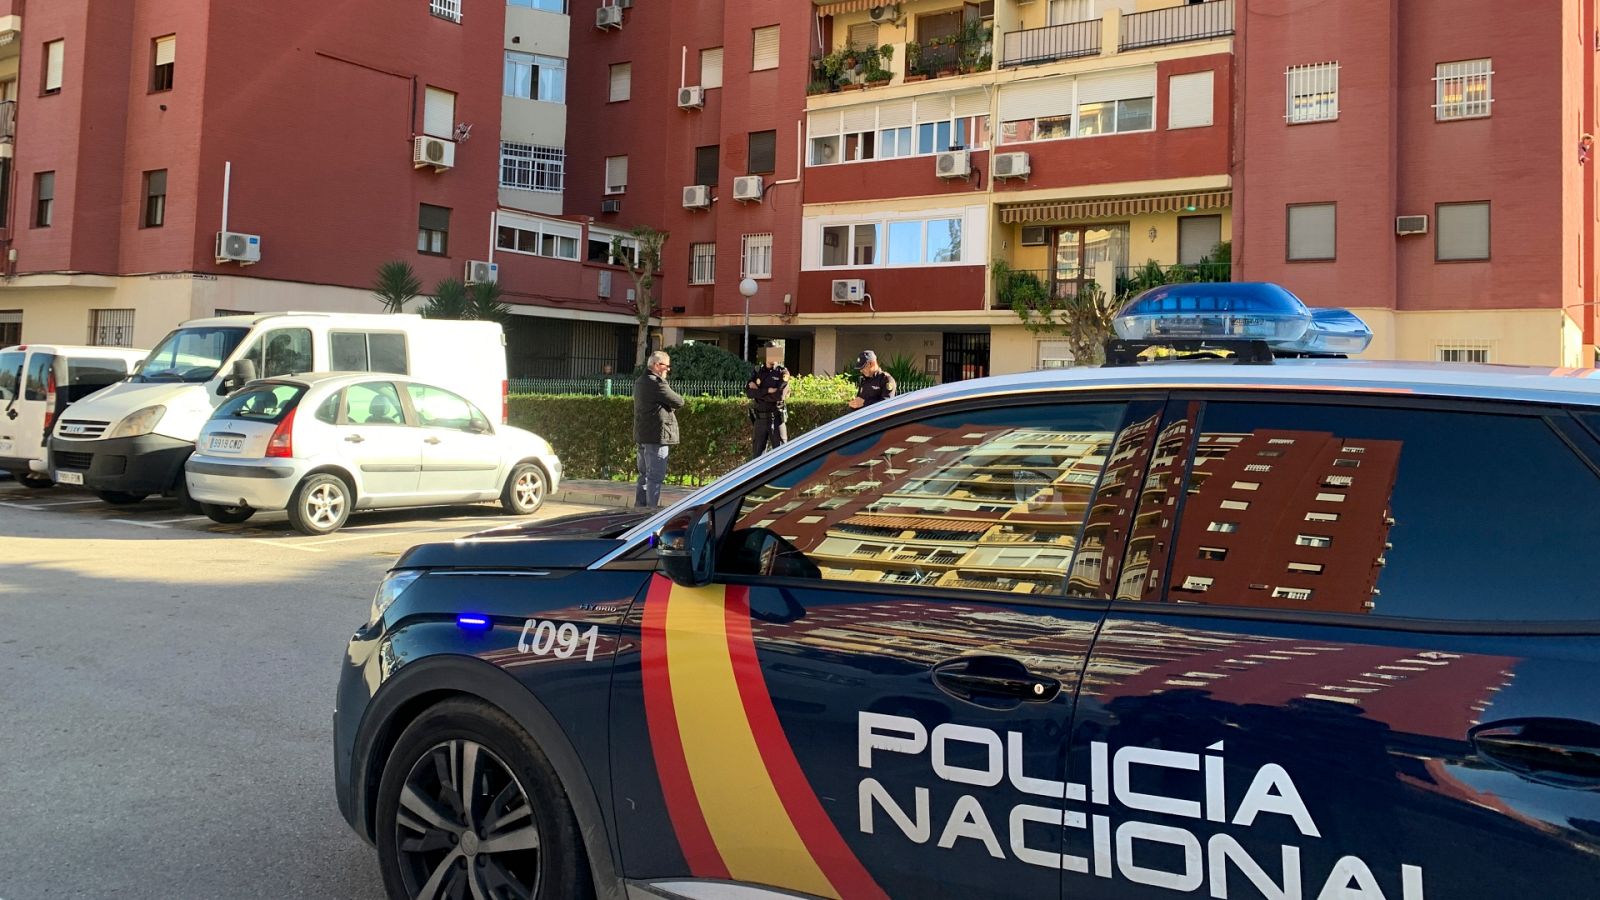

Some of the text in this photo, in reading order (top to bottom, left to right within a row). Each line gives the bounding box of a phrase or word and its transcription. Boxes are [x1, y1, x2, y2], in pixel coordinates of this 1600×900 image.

[579, 603, 617, 612] HYBRID
[532, 620, 599, 662] 091
[858, 711, 1322, 838] POLICÍA
